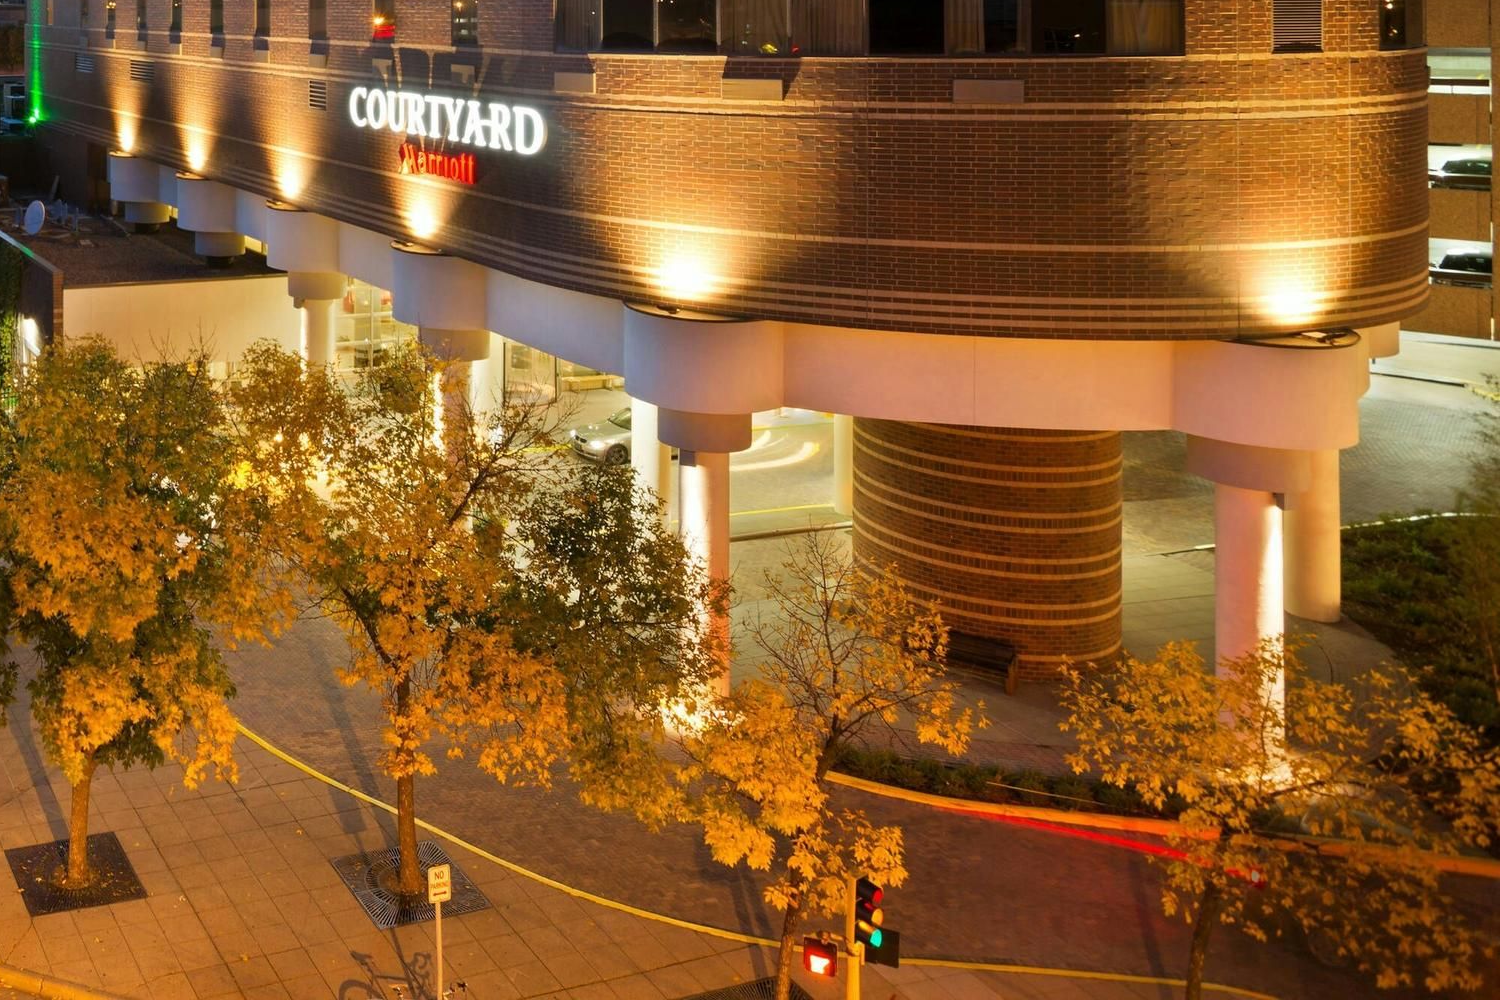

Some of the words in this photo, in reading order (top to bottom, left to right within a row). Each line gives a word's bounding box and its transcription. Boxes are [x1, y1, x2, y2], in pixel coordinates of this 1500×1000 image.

[349, 86, 546, 156] COURTYARD
[398, 143, 476, 184] Marriott
[434, 870, 445, 880] NO
